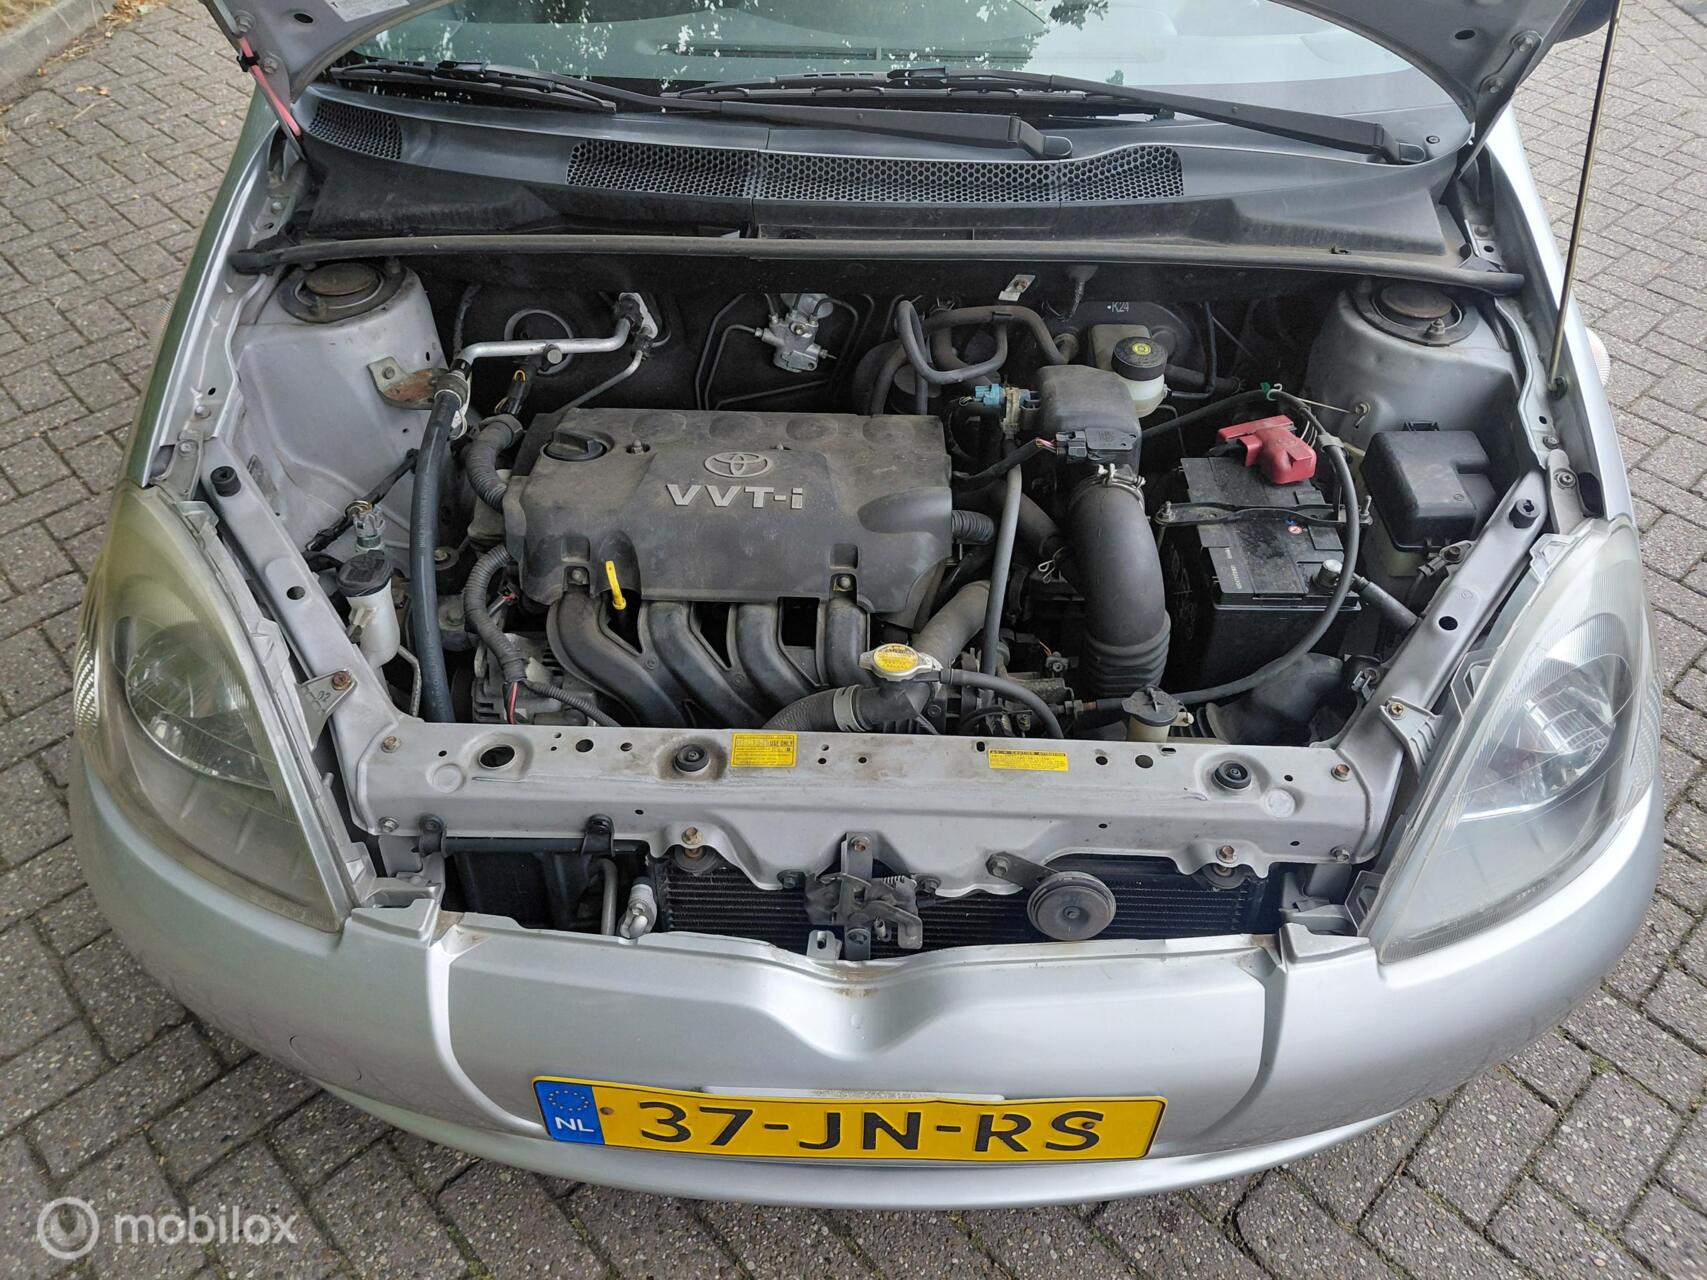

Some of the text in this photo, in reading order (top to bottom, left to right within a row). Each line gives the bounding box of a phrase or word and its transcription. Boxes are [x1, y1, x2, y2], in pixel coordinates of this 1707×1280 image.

[666, 484, 803, 509] VVT-i
[555, 1116, 594, 1133] NL
[639, 1101, 1104, 1152] 37-JN-RS
